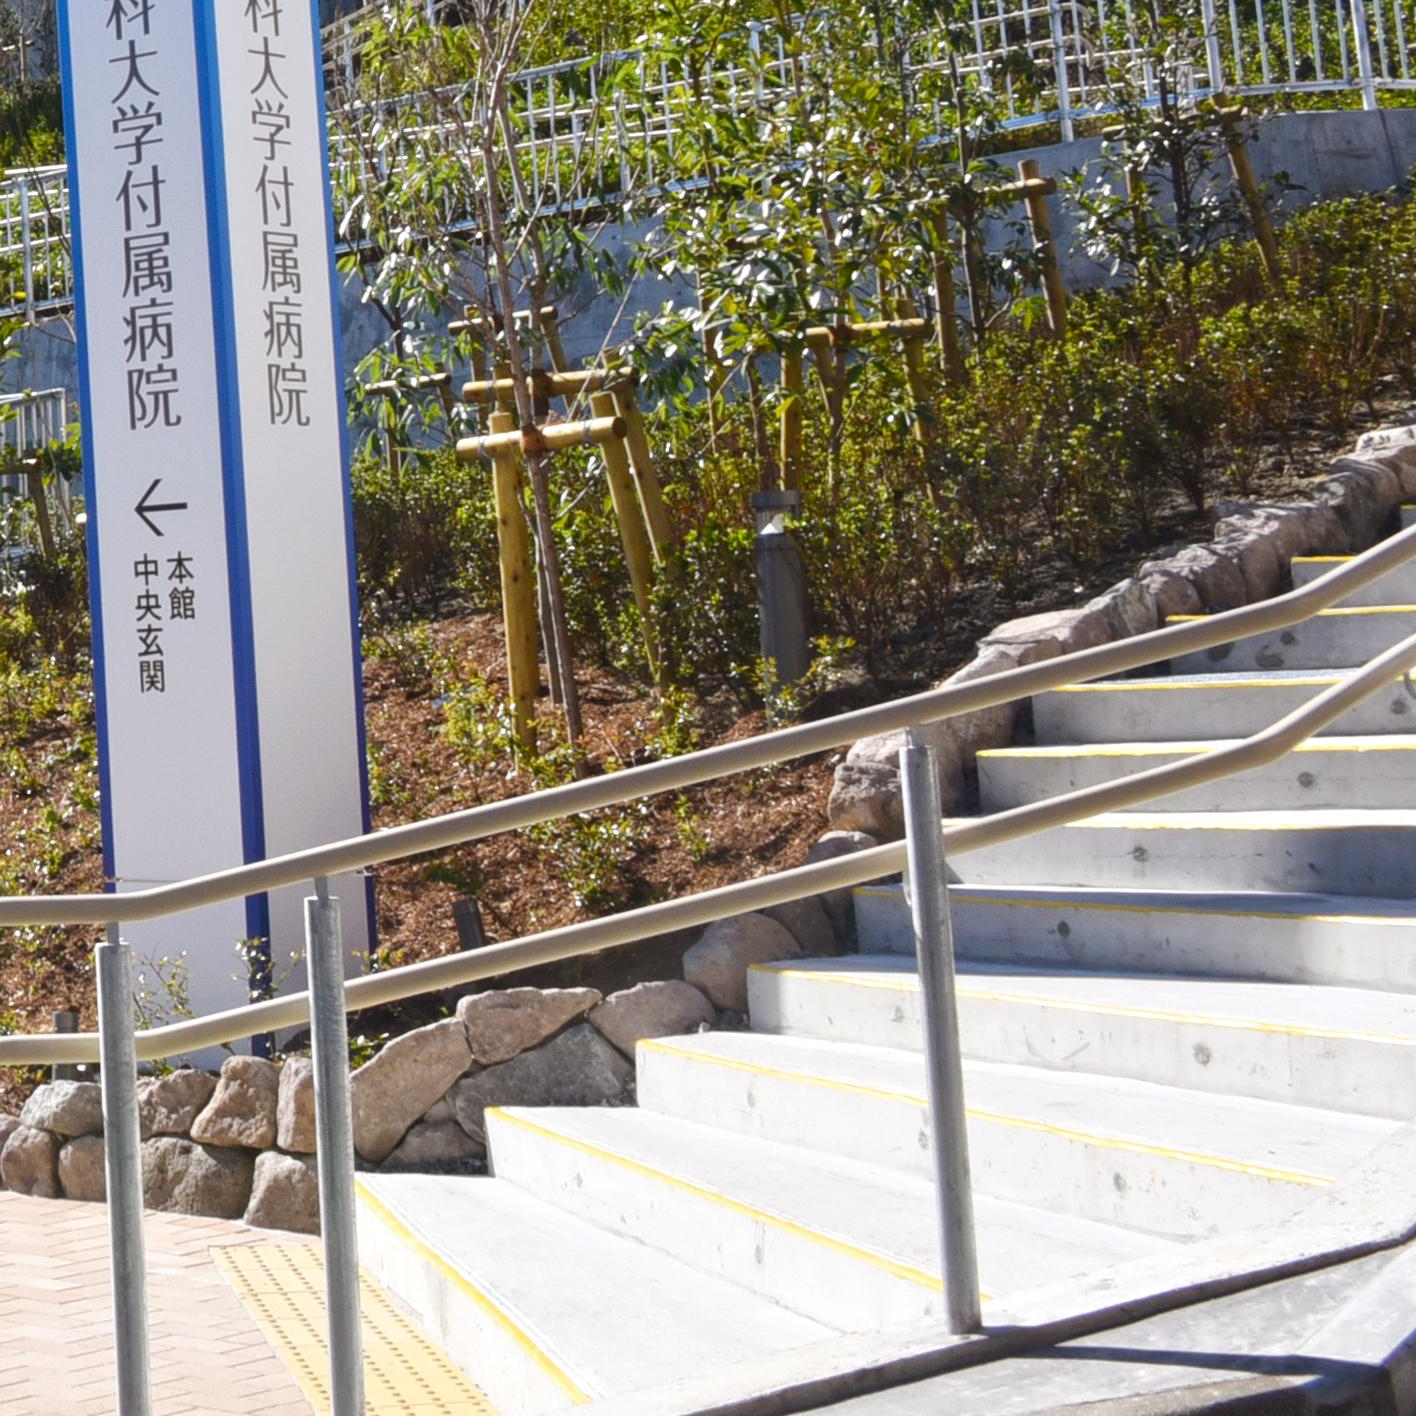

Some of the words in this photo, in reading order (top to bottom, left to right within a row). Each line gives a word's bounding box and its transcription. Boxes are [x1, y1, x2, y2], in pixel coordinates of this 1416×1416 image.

[133, 553, 165, 694] 中央玄関
[166, 550, 196, 621] 本館
